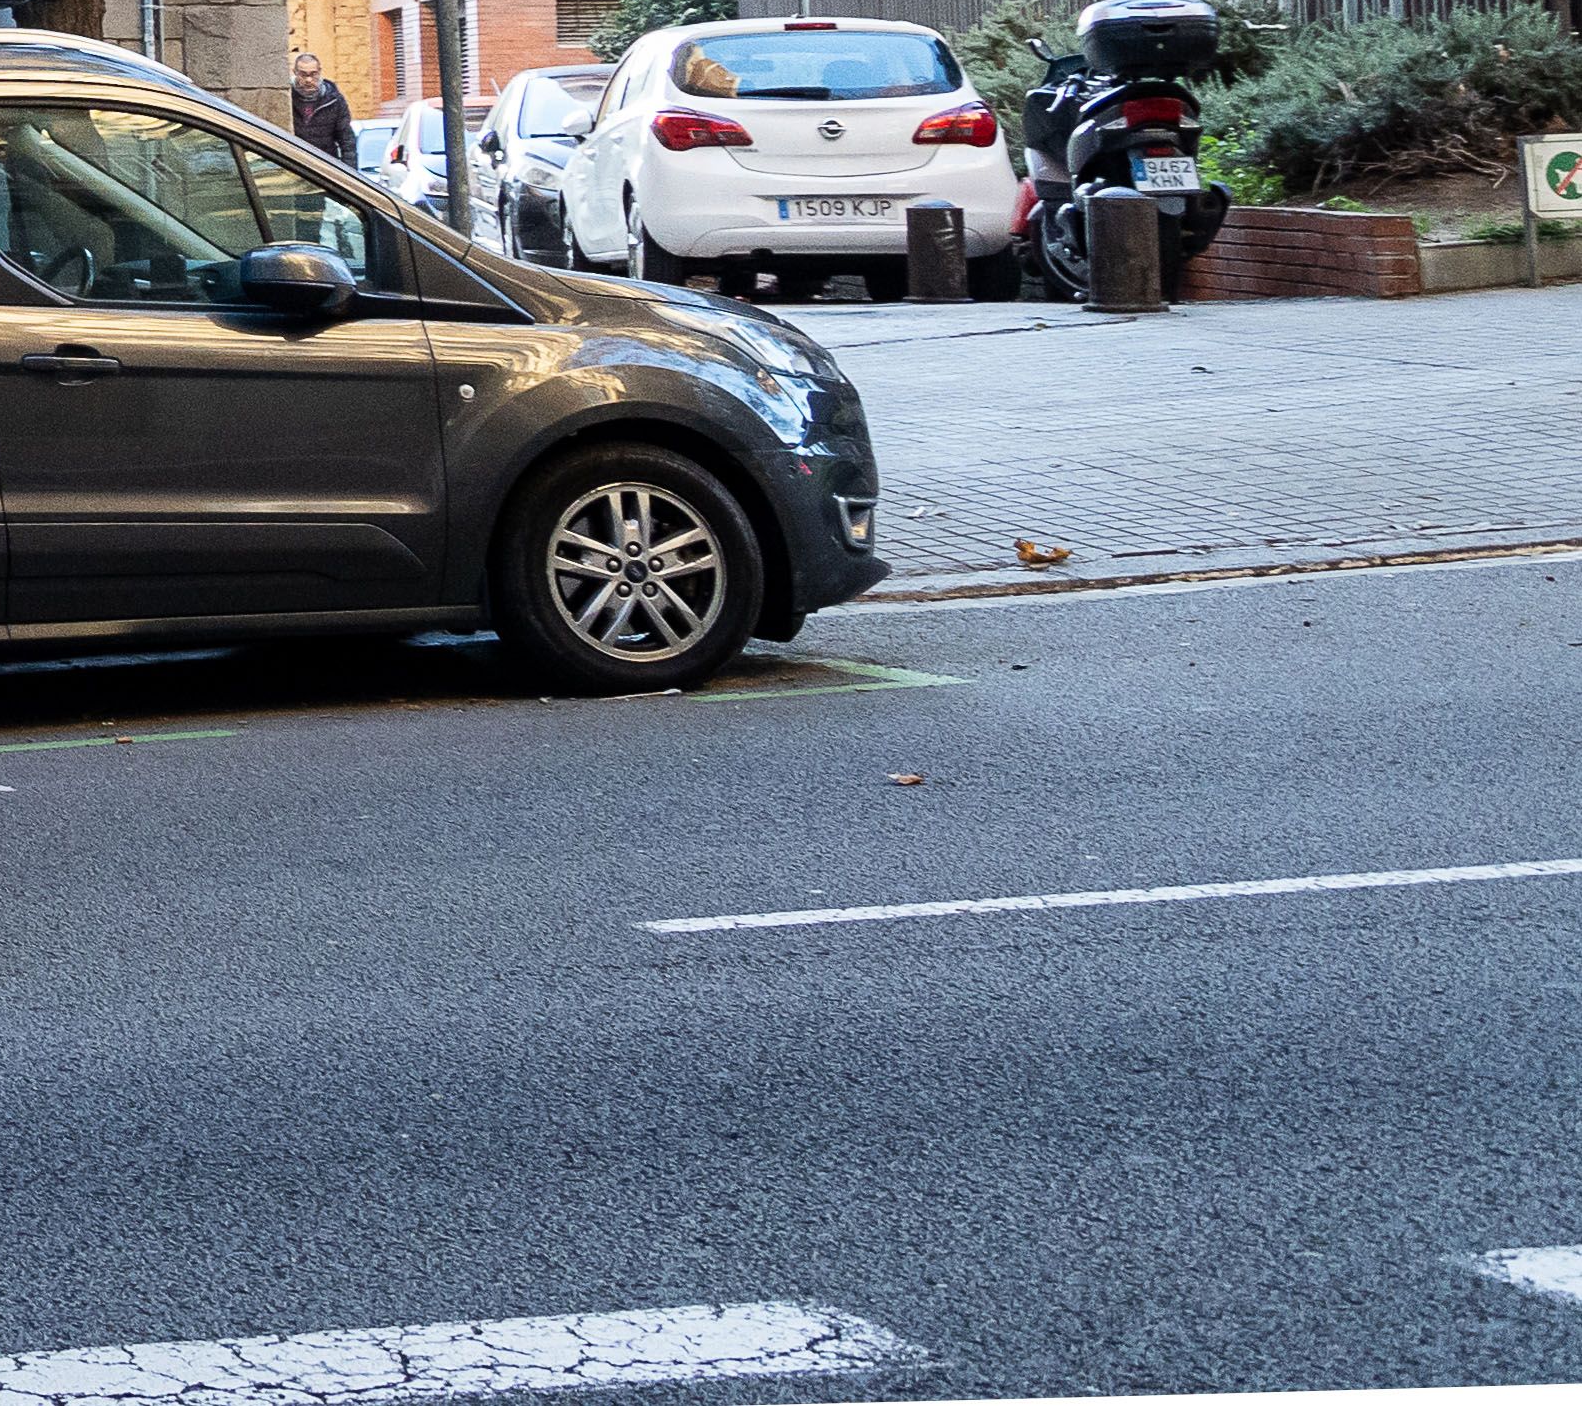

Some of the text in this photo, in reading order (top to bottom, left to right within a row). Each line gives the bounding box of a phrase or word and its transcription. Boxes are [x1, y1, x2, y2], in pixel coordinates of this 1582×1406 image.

[1147, 160, 1192, 174] 9462
[1150, 174, 1185, 188] KHN
[796, 199, 892, 217] 1509 KJP
